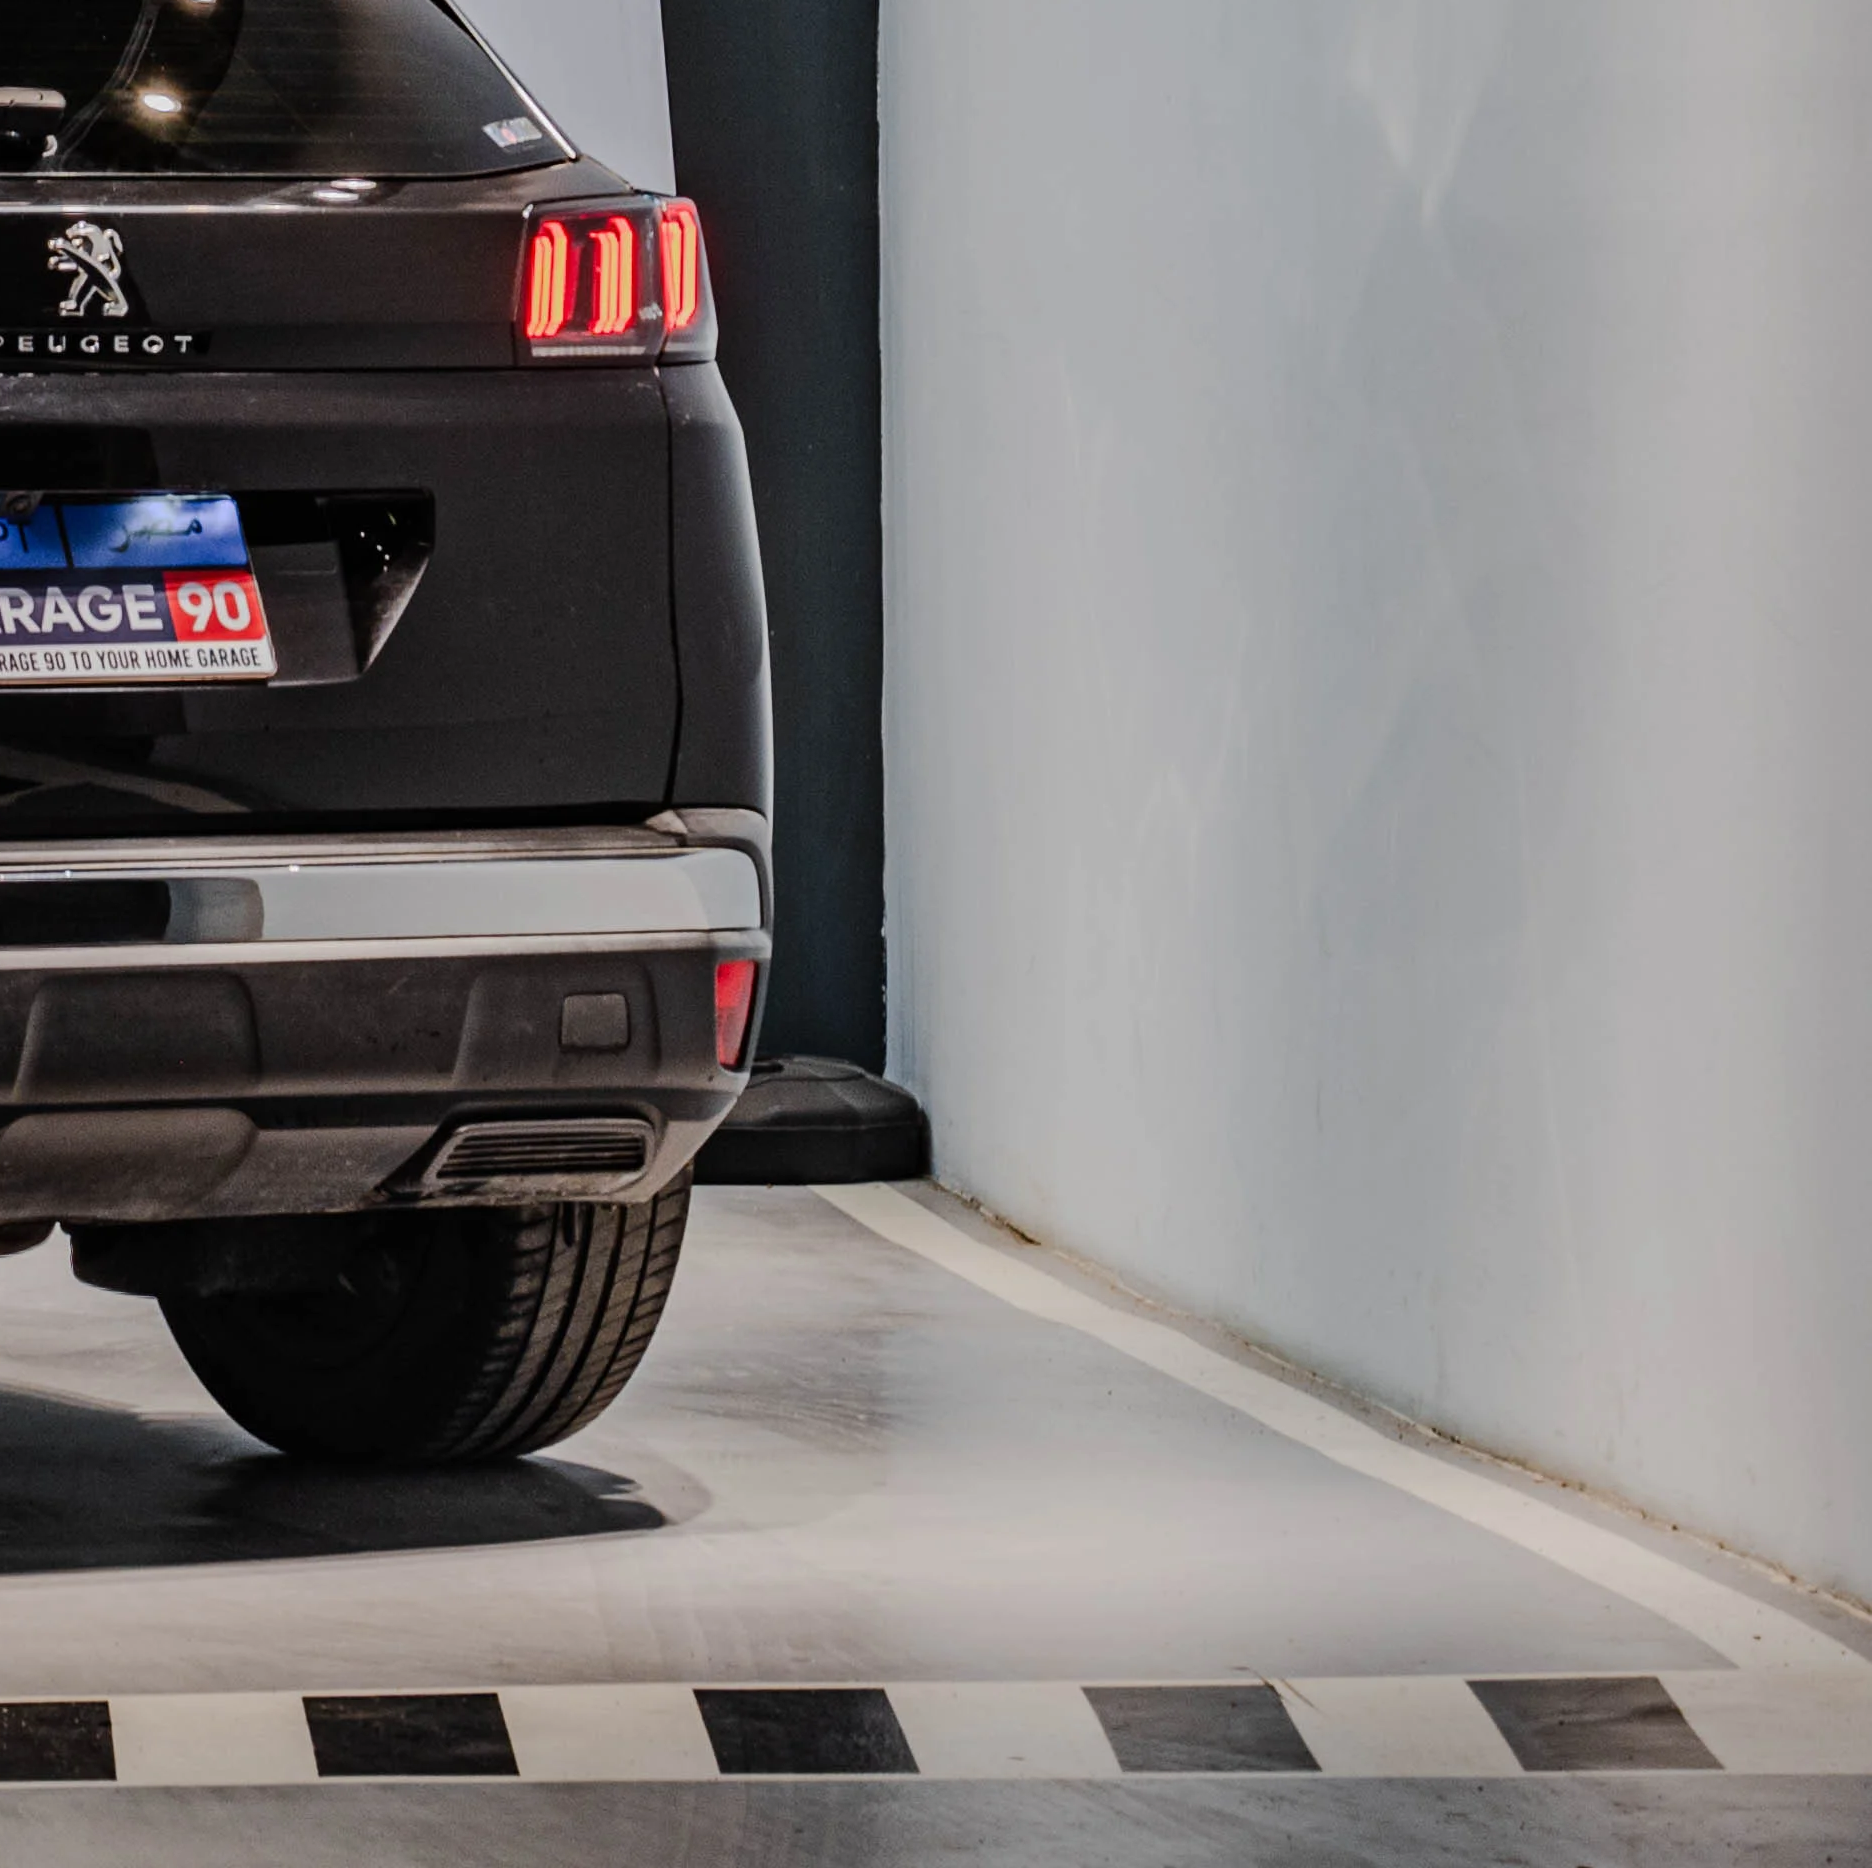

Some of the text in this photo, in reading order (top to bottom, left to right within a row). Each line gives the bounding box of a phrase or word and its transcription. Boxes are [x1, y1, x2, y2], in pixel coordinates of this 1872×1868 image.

[176, 580, 253, 633] 90
[44, 650, 66, 672] 90
[70, 650, 92, 671] TO
[96, 649, 140, 671] YOUR
[146, 647, 194, 669] HOME
[197, 646, 261, 668] GARAGE
